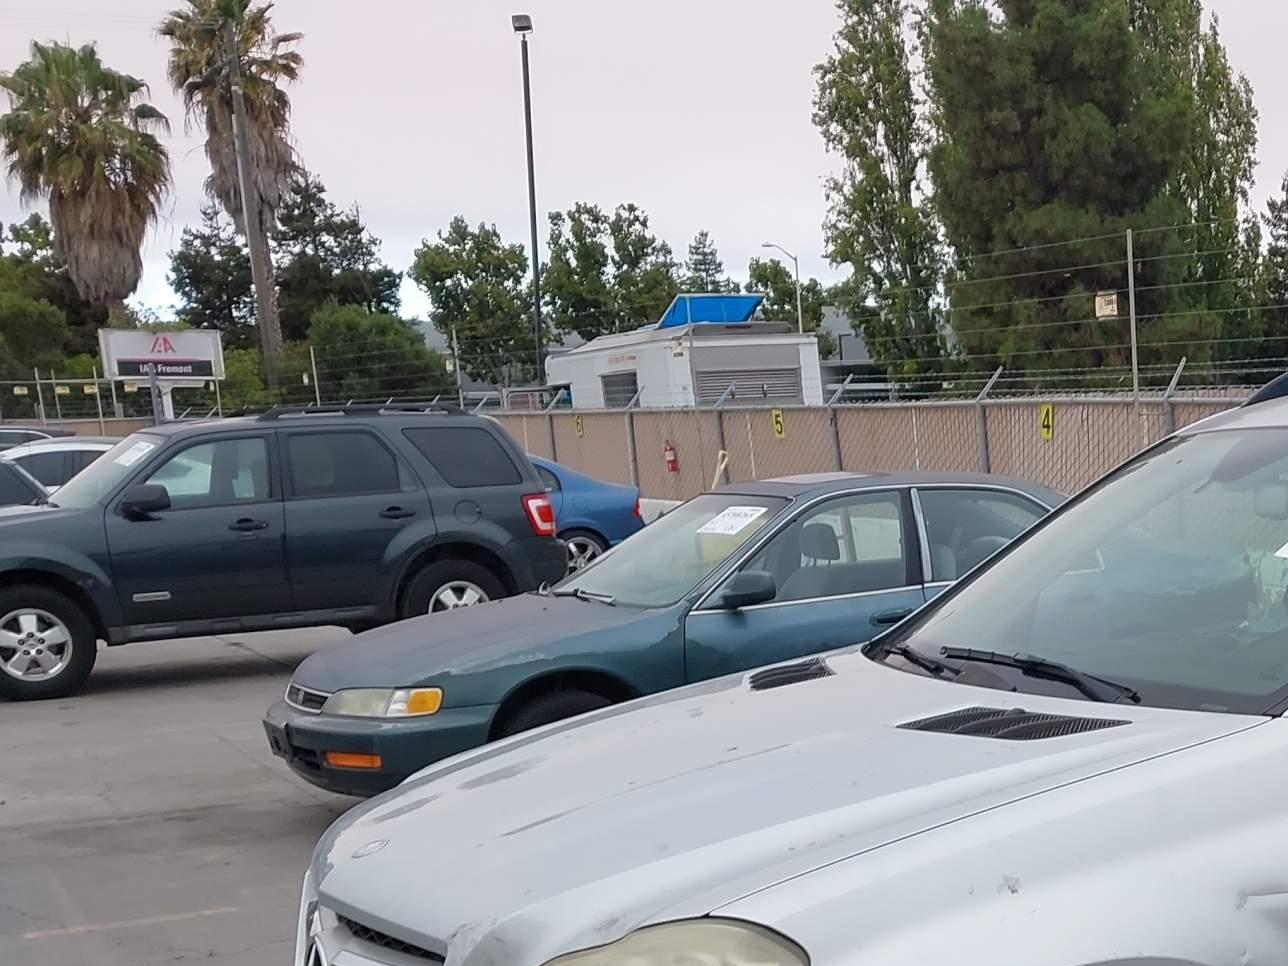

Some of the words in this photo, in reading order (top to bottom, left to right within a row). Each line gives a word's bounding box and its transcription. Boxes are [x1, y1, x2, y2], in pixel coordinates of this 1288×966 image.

[157, 364, 192, 373] Fremont
[774, 413, 783, 435] 5
[1042, 407, 1051, 435] 4
